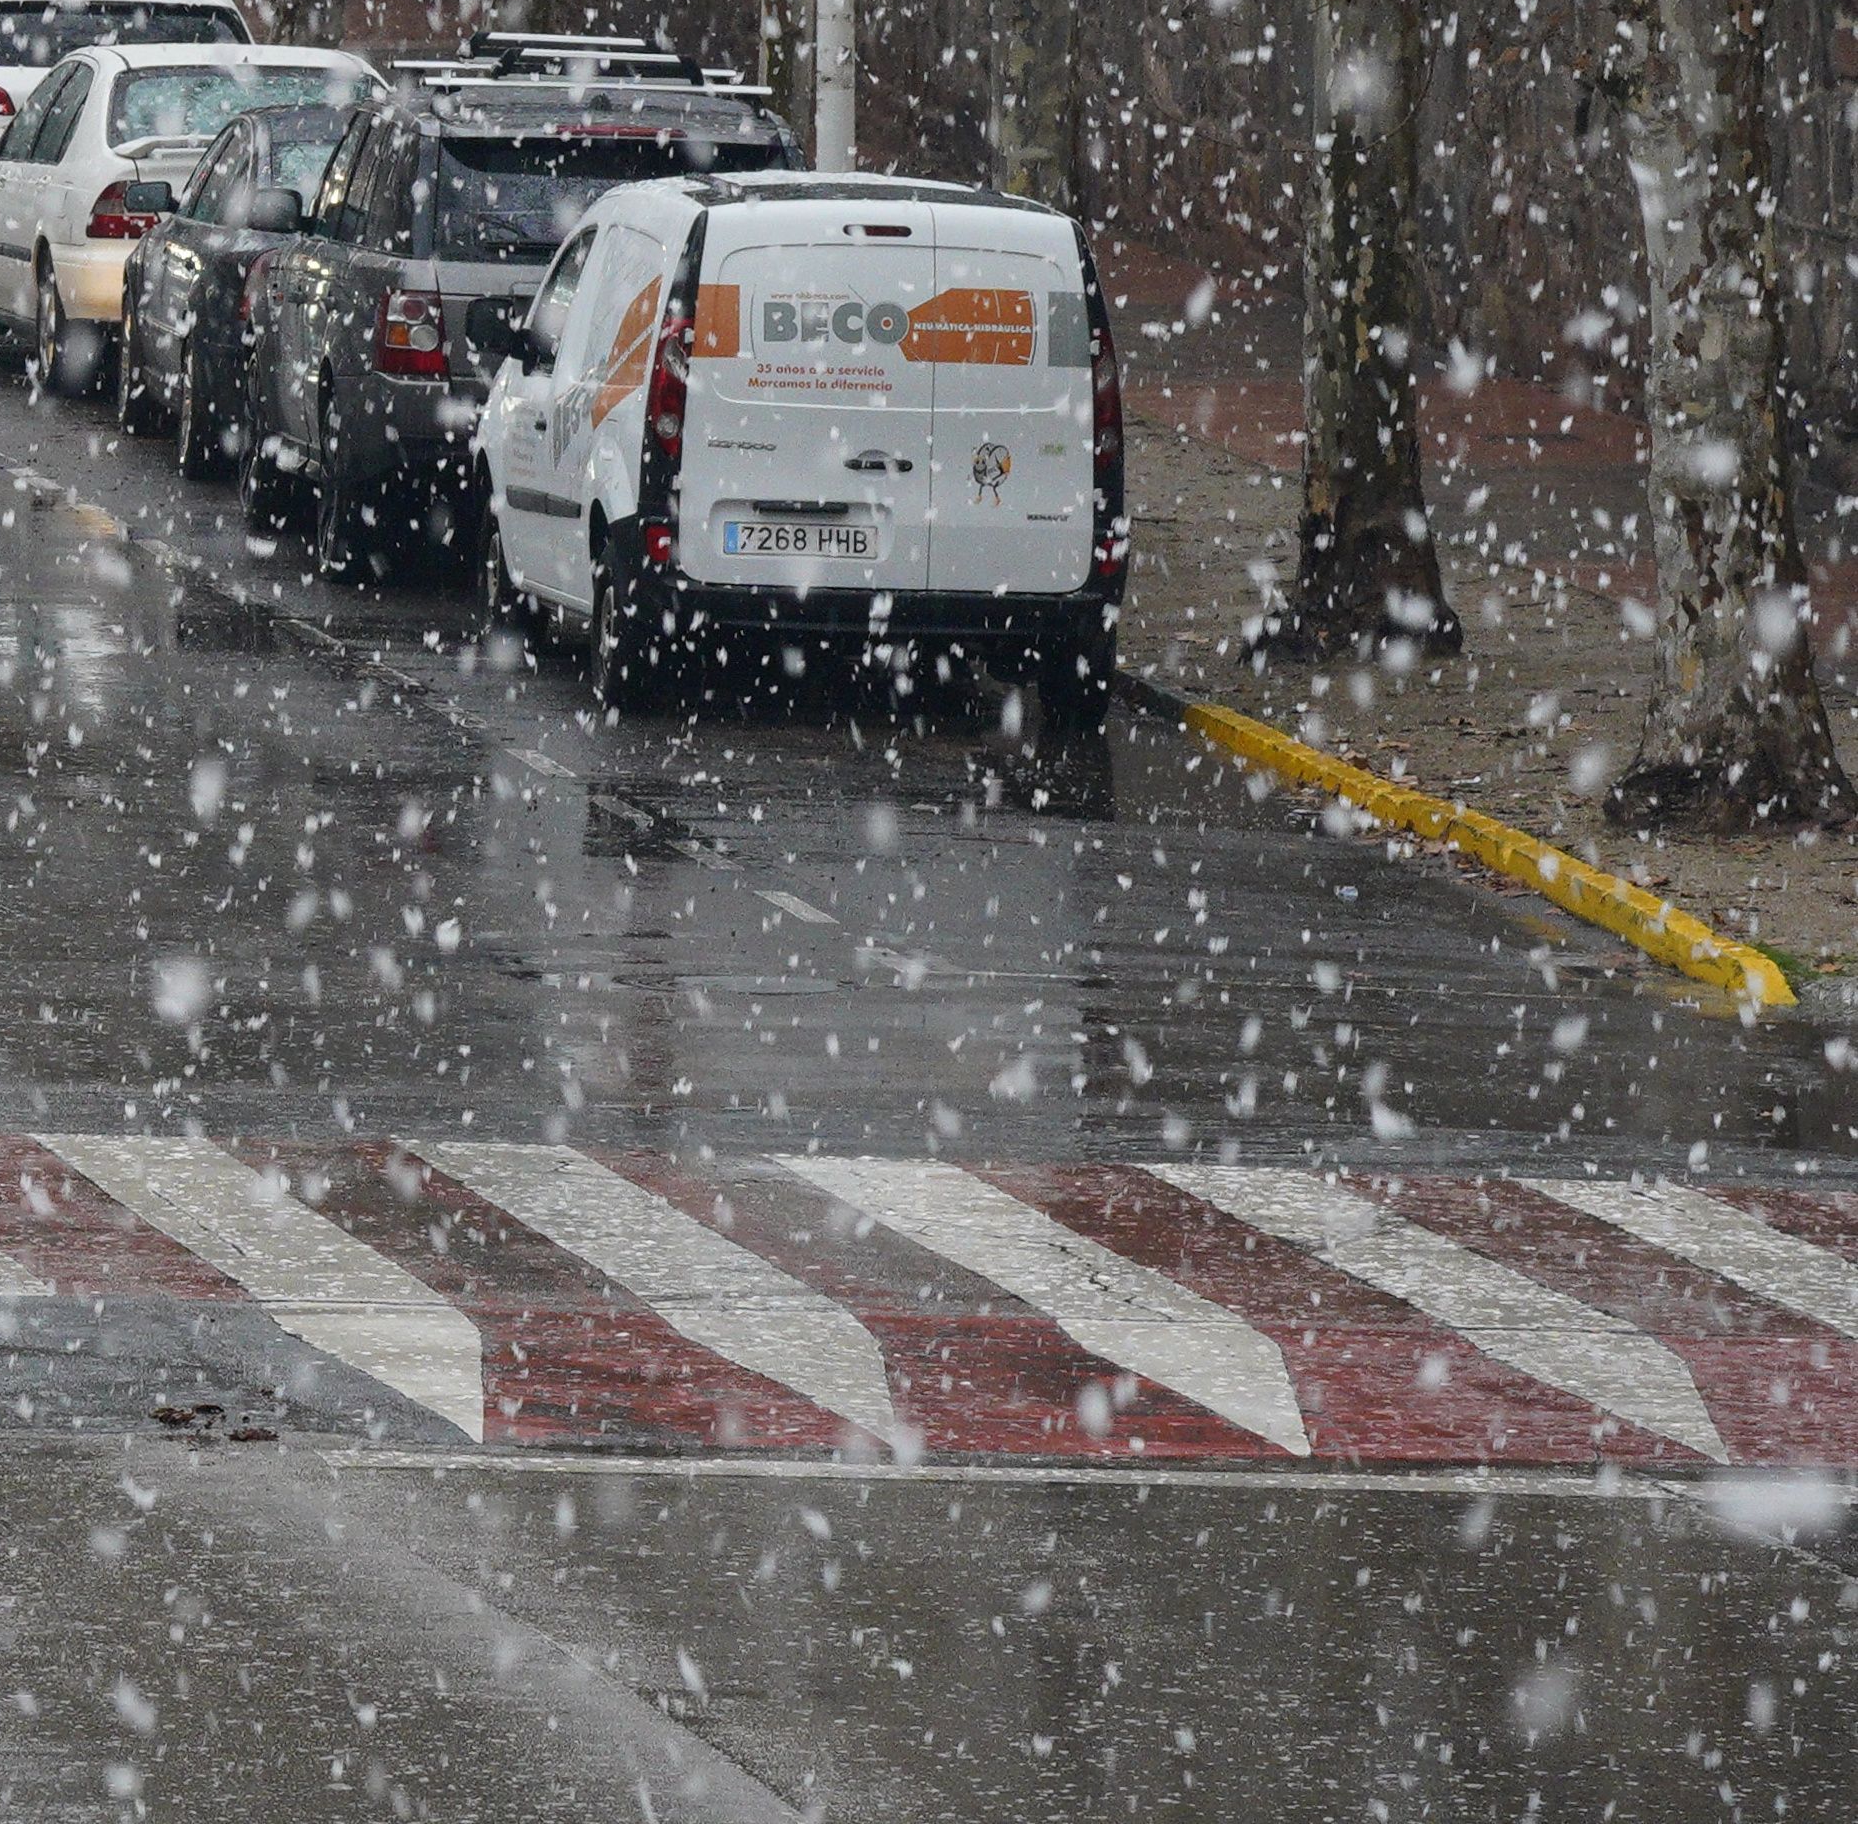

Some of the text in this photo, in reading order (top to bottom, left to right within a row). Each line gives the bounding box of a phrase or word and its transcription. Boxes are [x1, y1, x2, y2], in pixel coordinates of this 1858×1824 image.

[763, 302, 910, 346] BECO
[756, 363, 772, 374] 35
[776, 364, 805, 374] años
[809, 367, 817, 375] a
[838, 365, 885, 376] servicio
[748, 377, 892, 392] Marcamos la diferencia
[740, 525, 868, 554] 7268 HHB
